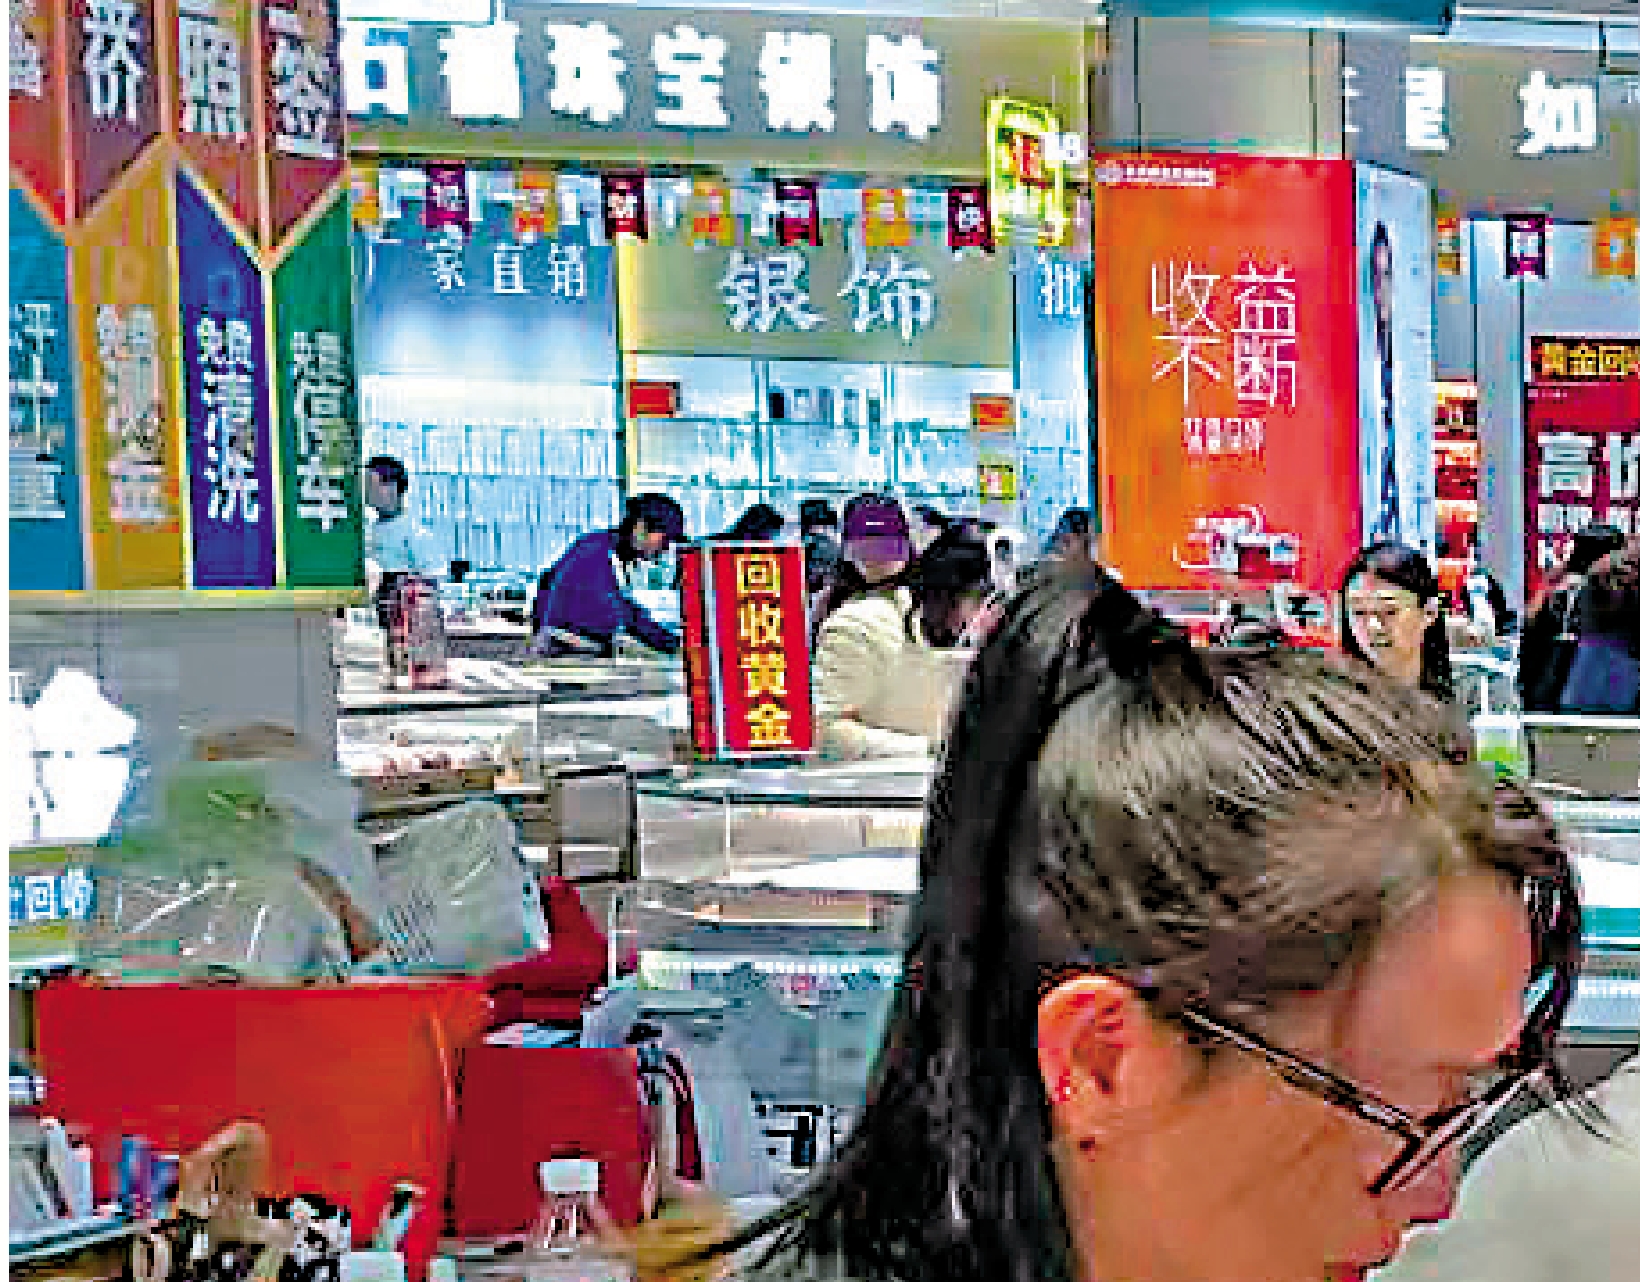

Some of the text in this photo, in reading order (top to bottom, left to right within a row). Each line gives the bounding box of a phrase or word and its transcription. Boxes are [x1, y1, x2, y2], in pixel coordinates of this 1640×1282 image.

[718, 248, 937, 342] 银饰
[1149, 259, 1297, 333] 收益
[1151, 333, 1298, 408] 不断
[734, 552, 796, 749] 回收黄金
